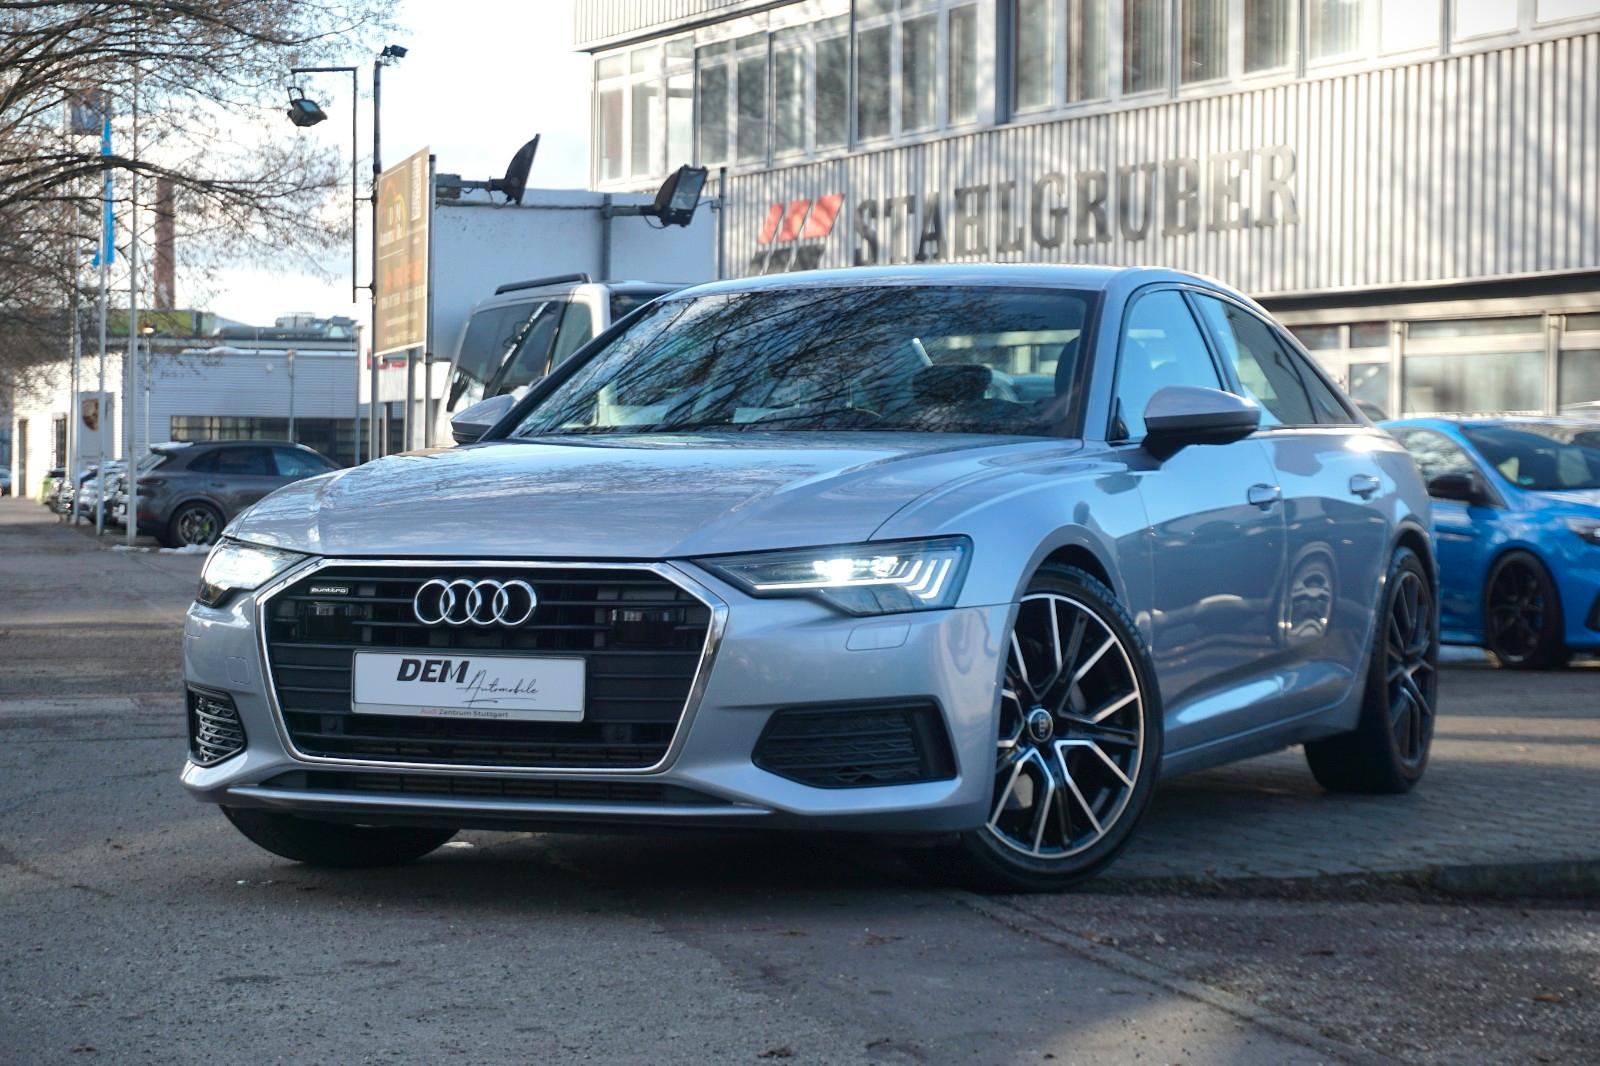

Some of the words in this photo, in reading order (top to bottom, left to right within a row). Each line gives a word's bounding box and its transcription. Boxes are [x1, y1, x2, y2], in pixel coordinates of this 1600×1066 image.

[854, 144, 1300, 267] STAHLGRUBER
[396, 658, 470, 683] DEM
[456, 669, 539, 706] Automobile
[439, 708, 472, 717] Zentrum
[473, 710, 509, 719] Stuttgart
